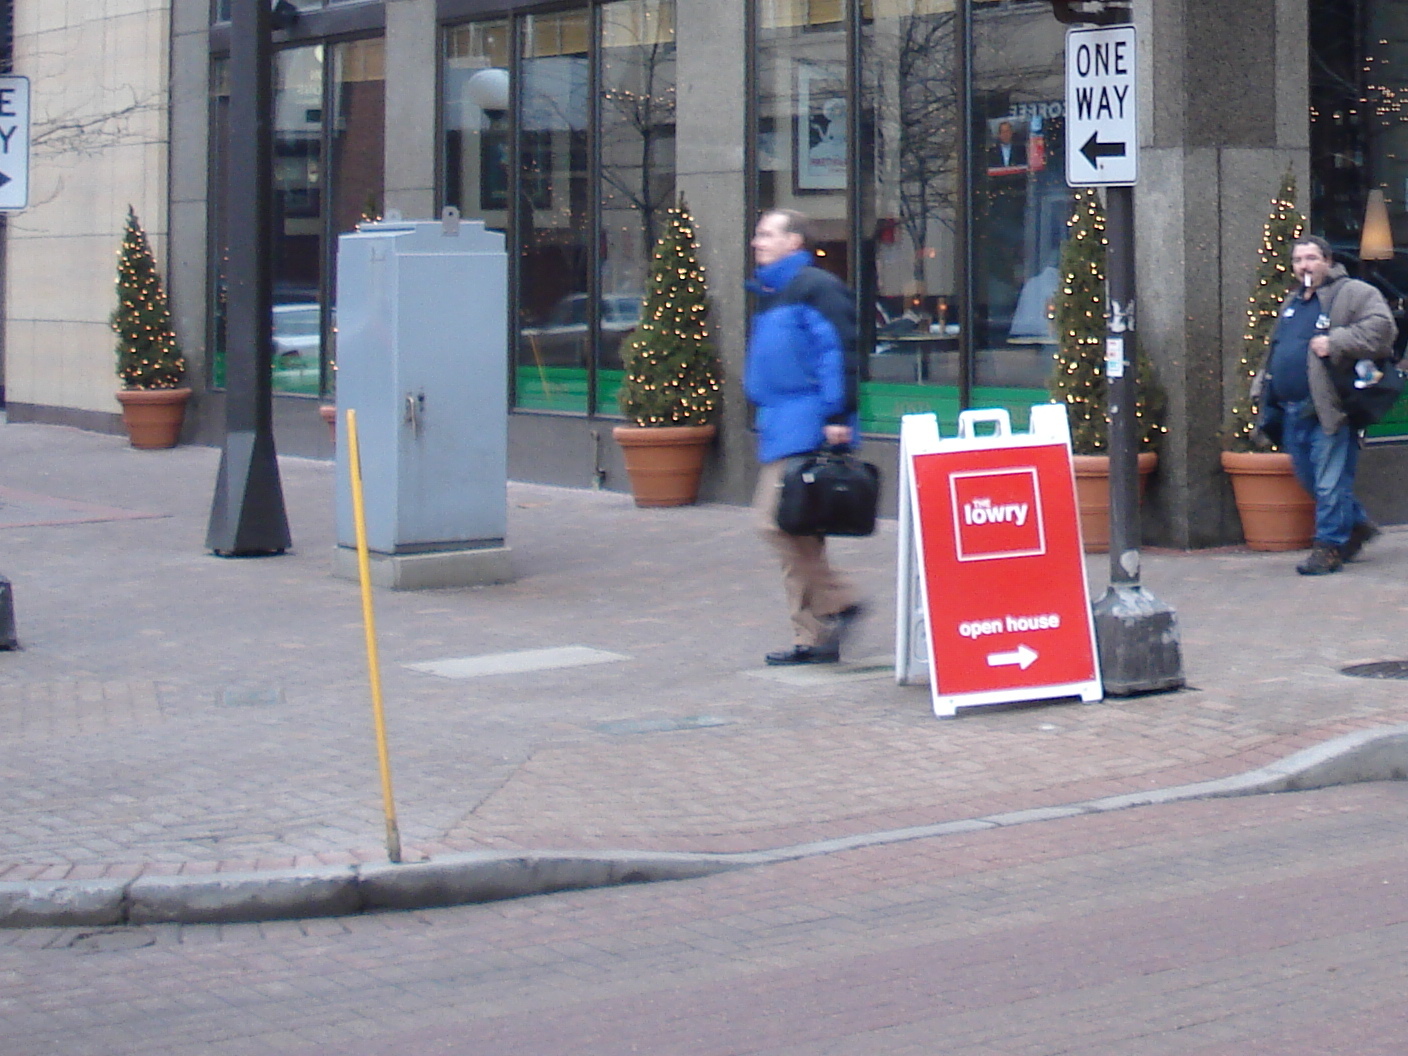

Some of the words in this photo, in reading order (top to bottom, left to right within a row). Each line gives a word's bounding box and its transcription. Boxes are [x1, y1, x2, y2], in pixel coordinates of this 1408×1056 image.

[1076, 41, 1128, 78] ONE
[1076, 84, 1129, 121] WAY
[964, 503, 1028, 526] lowry
[972, 498, 992, 510] THE
[958, 621, 1003, 639] open
[1005, 614, 1060, 632] house
